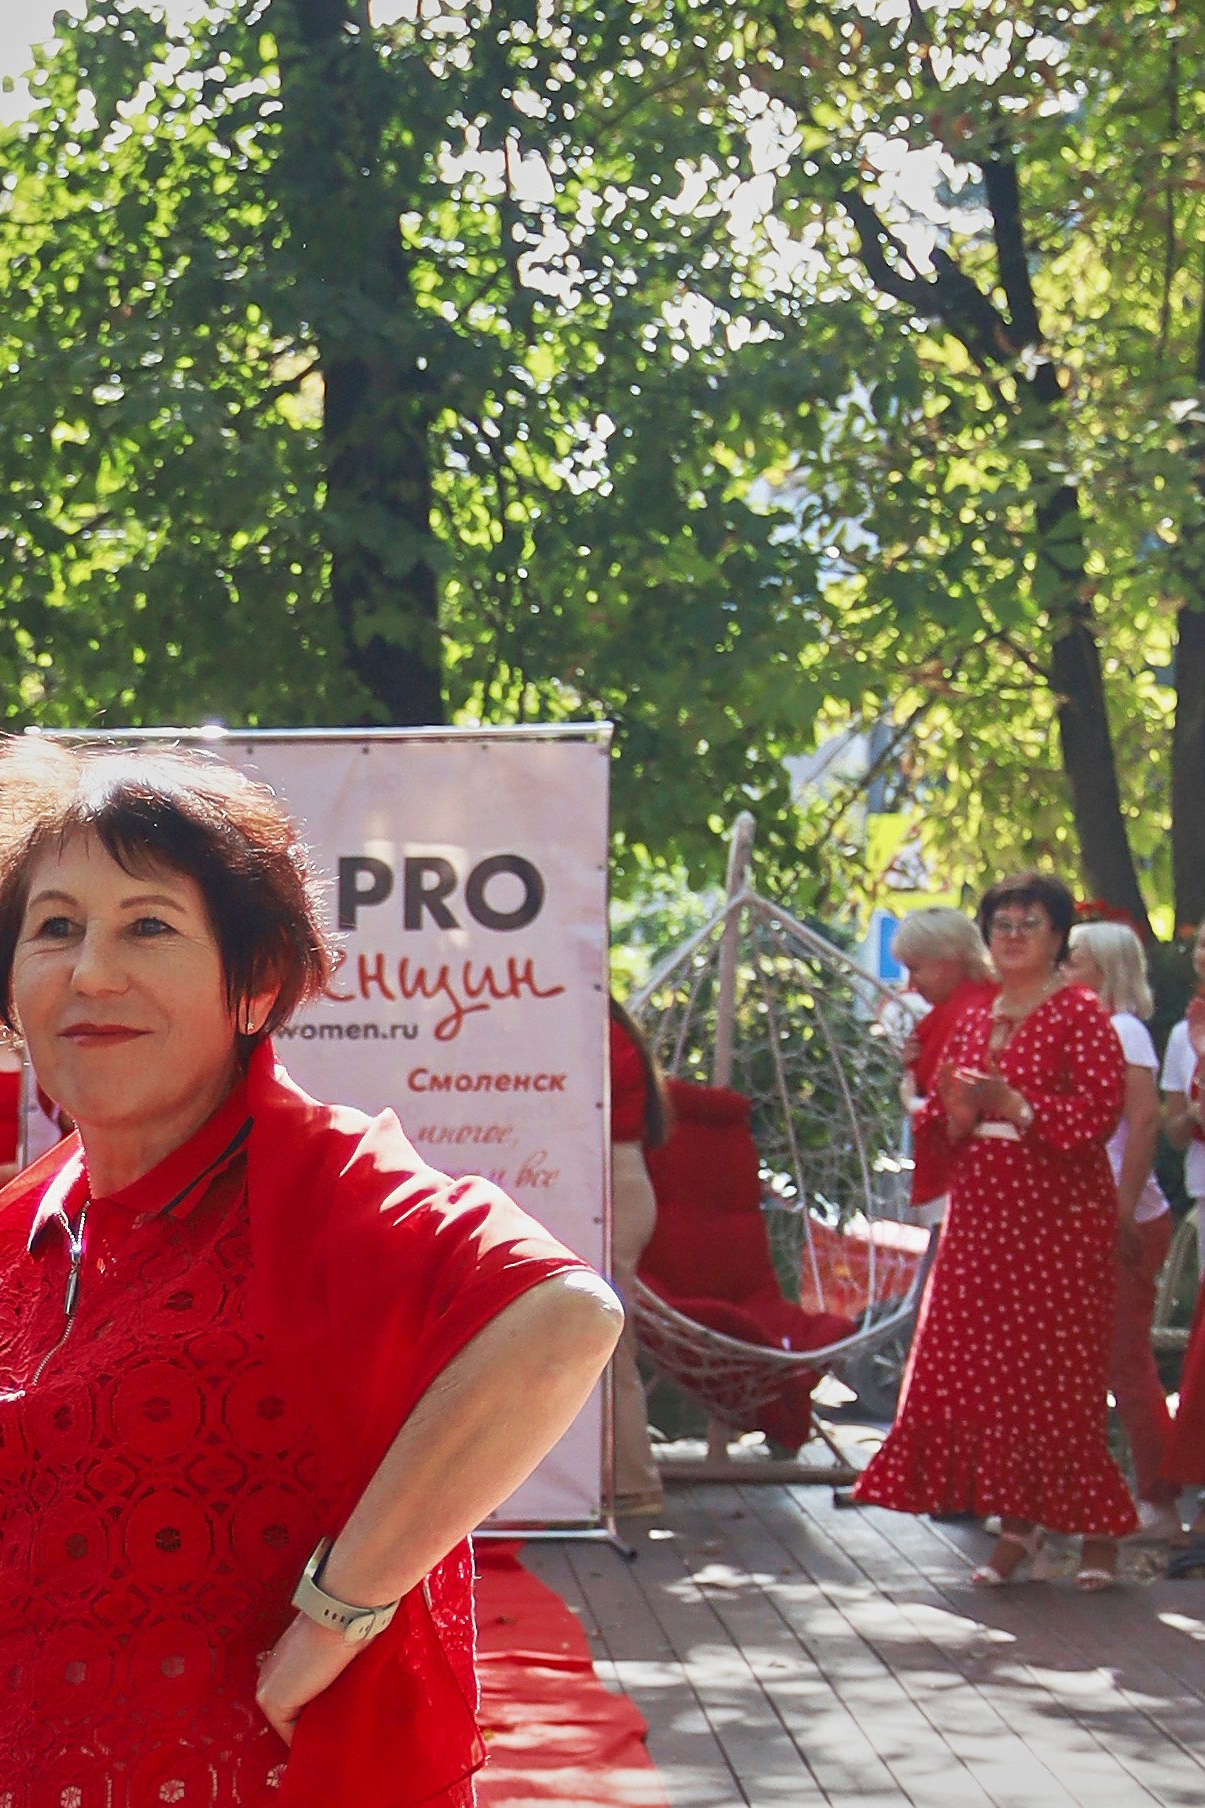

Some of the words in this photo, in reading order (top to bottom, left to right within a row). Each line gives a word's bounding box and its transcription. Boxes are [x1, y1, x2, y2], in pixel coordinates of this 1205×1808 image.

[337, 854, 545, 931] PRO
[321, 948, 565, 1041] енщин
[407, 1067, 568, 1093] Смоленск
